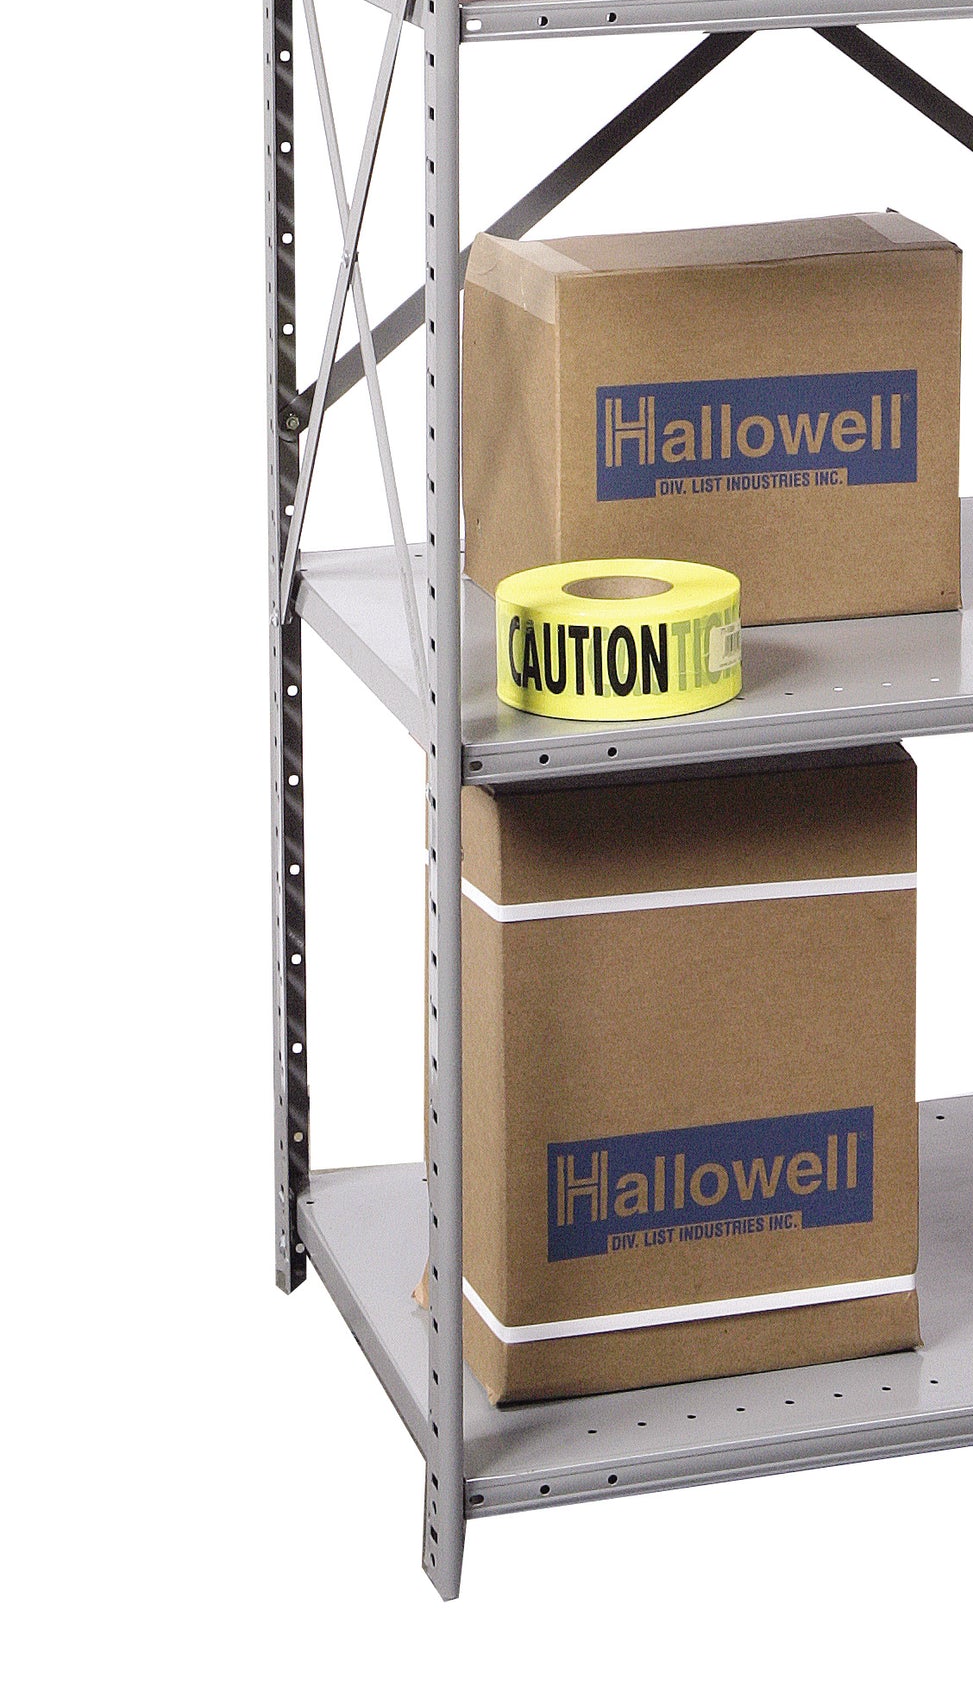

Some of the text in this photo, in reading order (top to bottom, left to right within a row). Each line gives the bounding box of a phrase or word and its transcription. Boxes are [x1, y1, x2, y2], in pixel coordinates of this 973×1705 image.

[605, 393, 902, 468] Hallowell
[660, 470, 843, 496] DIV. LIST INDUSTRIES INC.
[508, 615, 669, 697] CAUTION
[556, 1131, 859, 1227] Hallowell
[611, 1211, 799, 1252] DIV. LIST INDUSTRIES INC.
